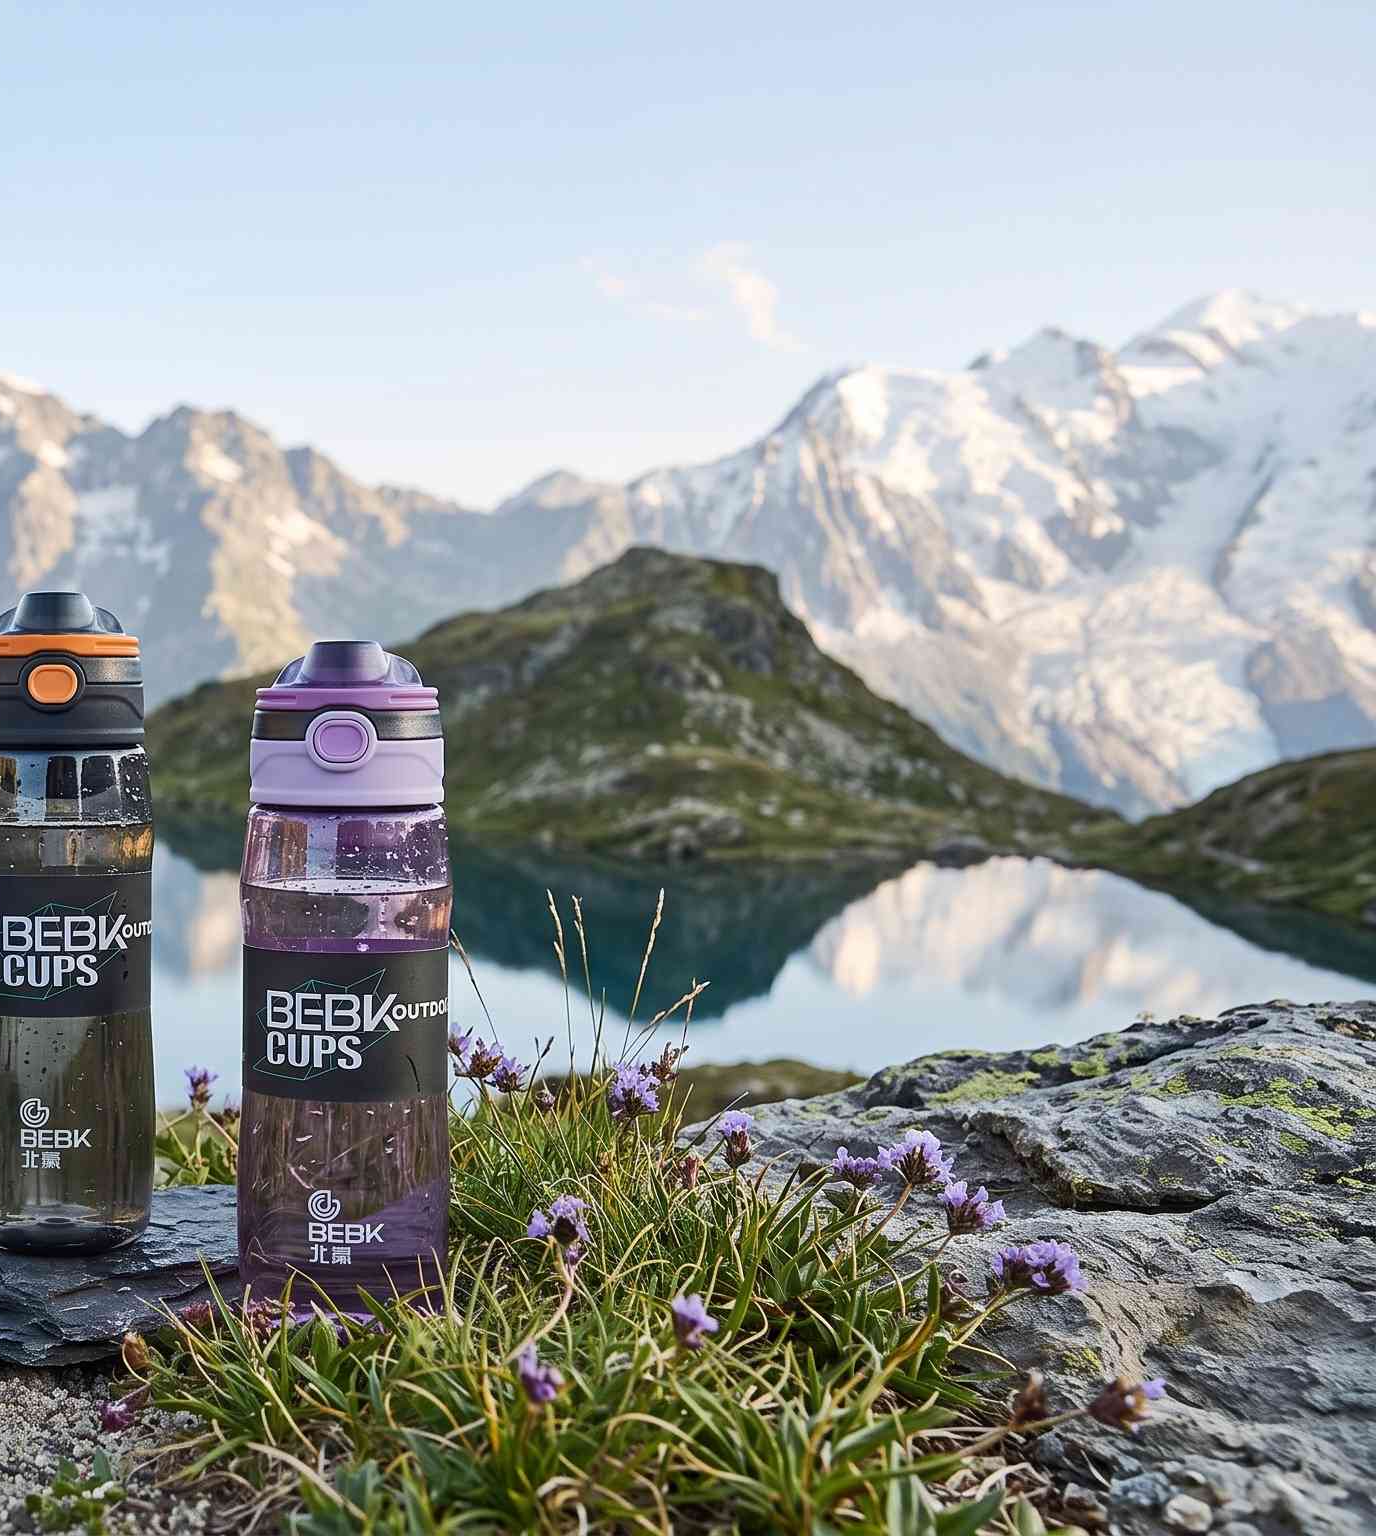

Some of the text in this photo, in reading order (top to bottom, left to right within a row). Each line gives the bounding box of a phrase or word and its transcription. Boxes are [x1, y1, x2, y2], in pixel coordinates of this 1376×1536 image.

[2, 914, 128, 952] BEBK
[3, 953, 99, 988] CUPS
[266, 989, 400, 1032] BEBK
[266, 1030, 363, 1070] CUPS
[20, 1128, 93, 1149] BEBK
[308, 1222, 385, 1244] BEBK
